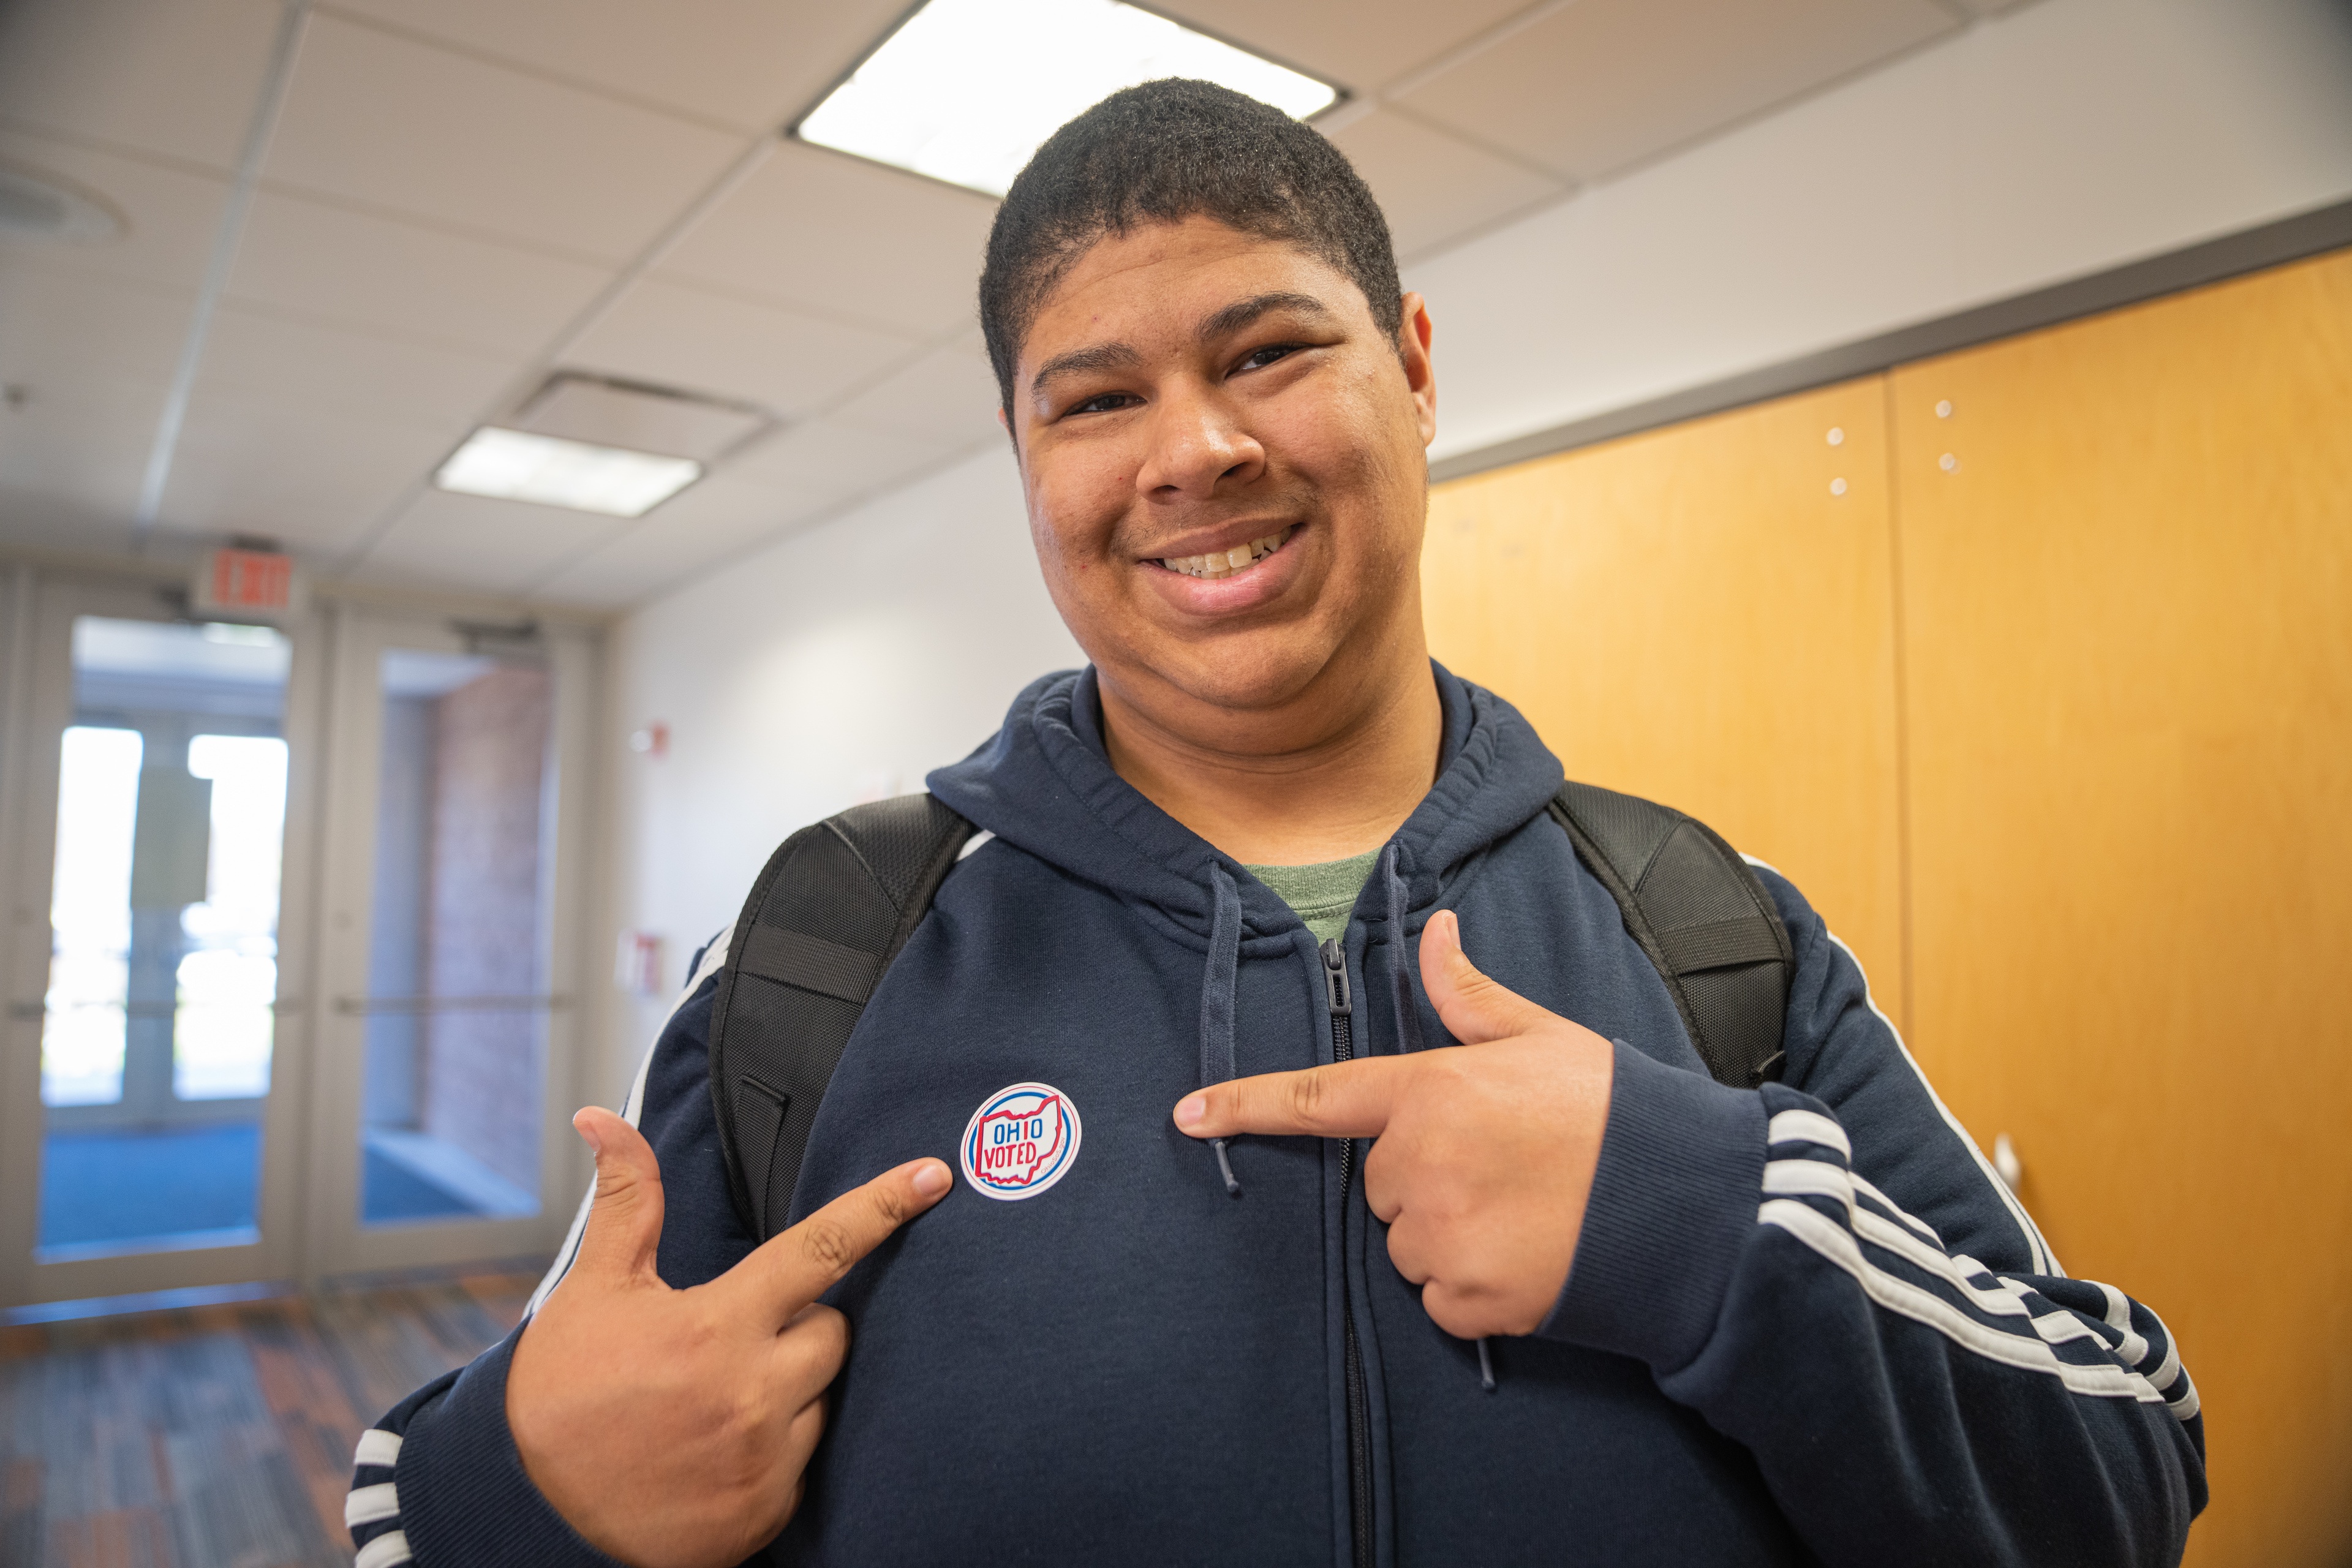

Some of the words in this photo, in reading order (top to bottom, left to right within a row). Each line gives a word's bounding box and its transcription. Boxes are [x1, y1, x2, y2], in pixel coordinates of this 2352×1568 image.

[994, 1118, 1042, 1144] OHIO
[984, 1142, 1036, 1169] VOTED
[1041, 1137, 1065, 1174] OhioSoS.gov
